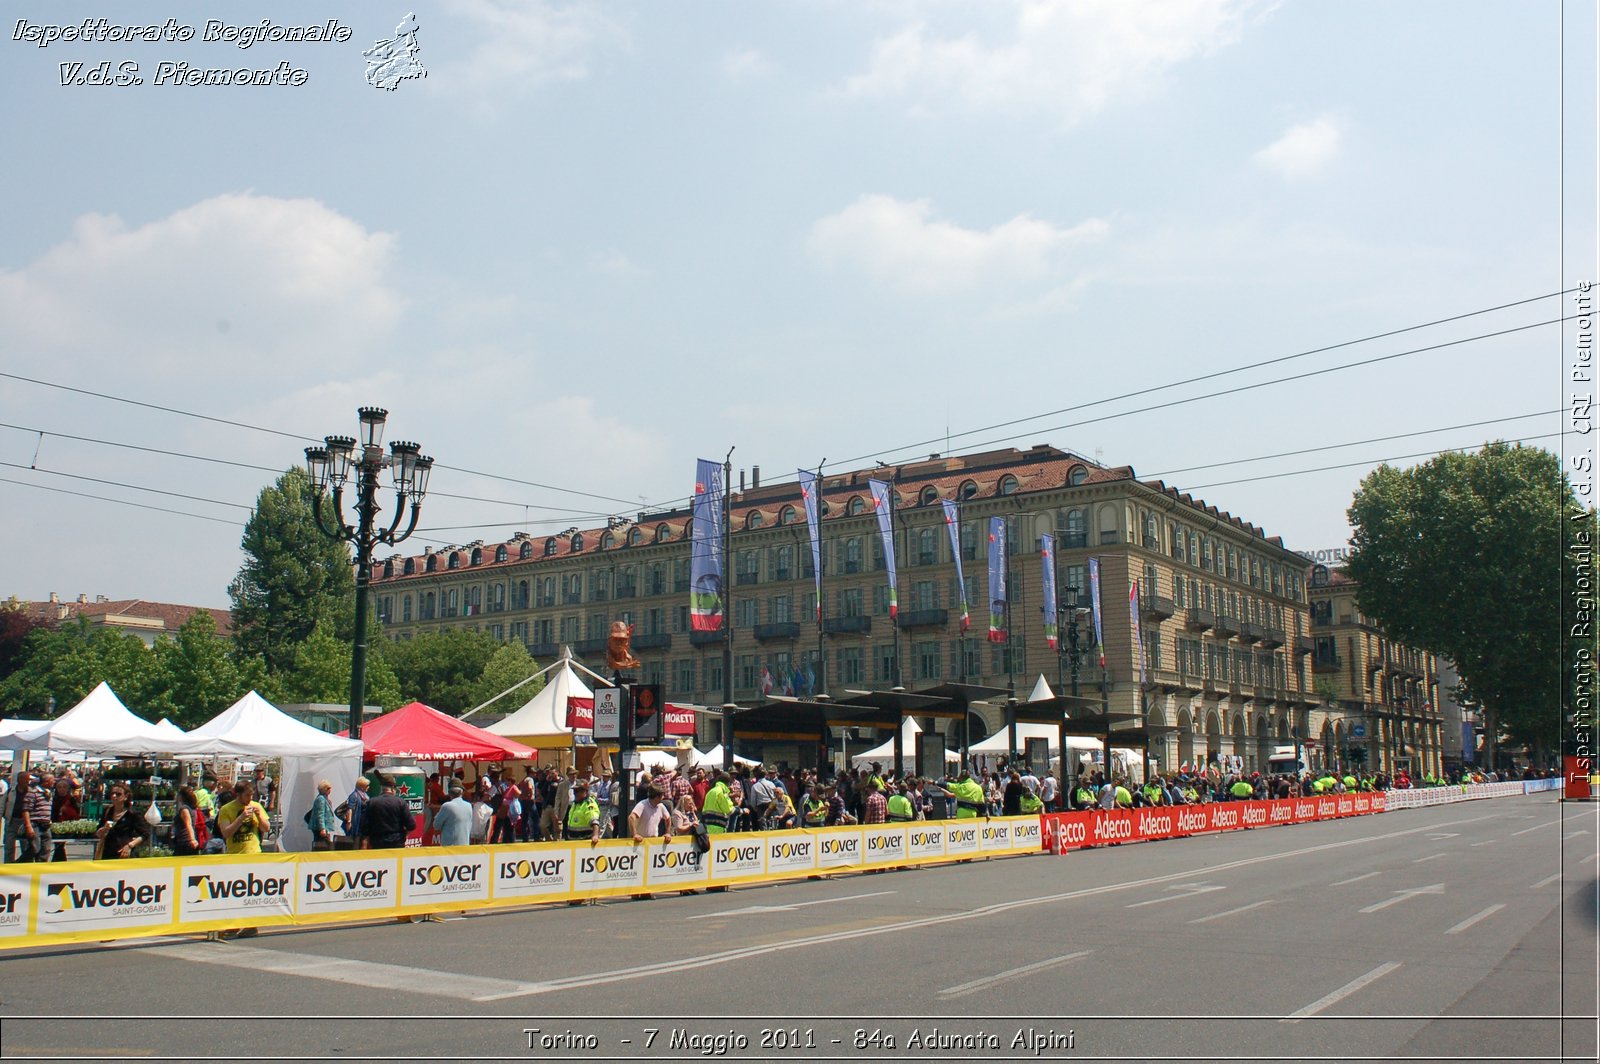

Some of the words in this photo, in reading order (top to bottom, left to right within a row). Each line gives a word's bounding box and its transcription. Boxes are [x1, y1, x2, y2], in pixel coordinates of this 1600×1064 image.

[575, 706, 594, 719] BIRR
[433, 751, 474, 760] MORETTI
[1242, 804, 1267, 824] Adecco
[1270, 802, 1292, 821] Adecco
[1295, 800, 1315, 818] Adecco
[1318, 797, 1336, 816] Adecco
[1094, 814, 1131, 840] Adecco
[1139, 812, 1171, 837] Adecco
[1178, 809, 1207, 833] Adecco
[1211, 806, 1238, 829] Adecco
[1043, 818, 1086, 846] Aecco
[529, 874, 565, 885] SAINT-GOBAIN
[606, 871, 638, 879] SAINT-GOBAIN
[70, 879, 167, 909] weber
[207, 873, 289, 899] weber
[343, 888, 388, 900] SAINT-GOBAIN
[442, 881, 482, 892] SAINT-GOBAIN
[112, 904, 167, 916] SAINT-GOBAIN
